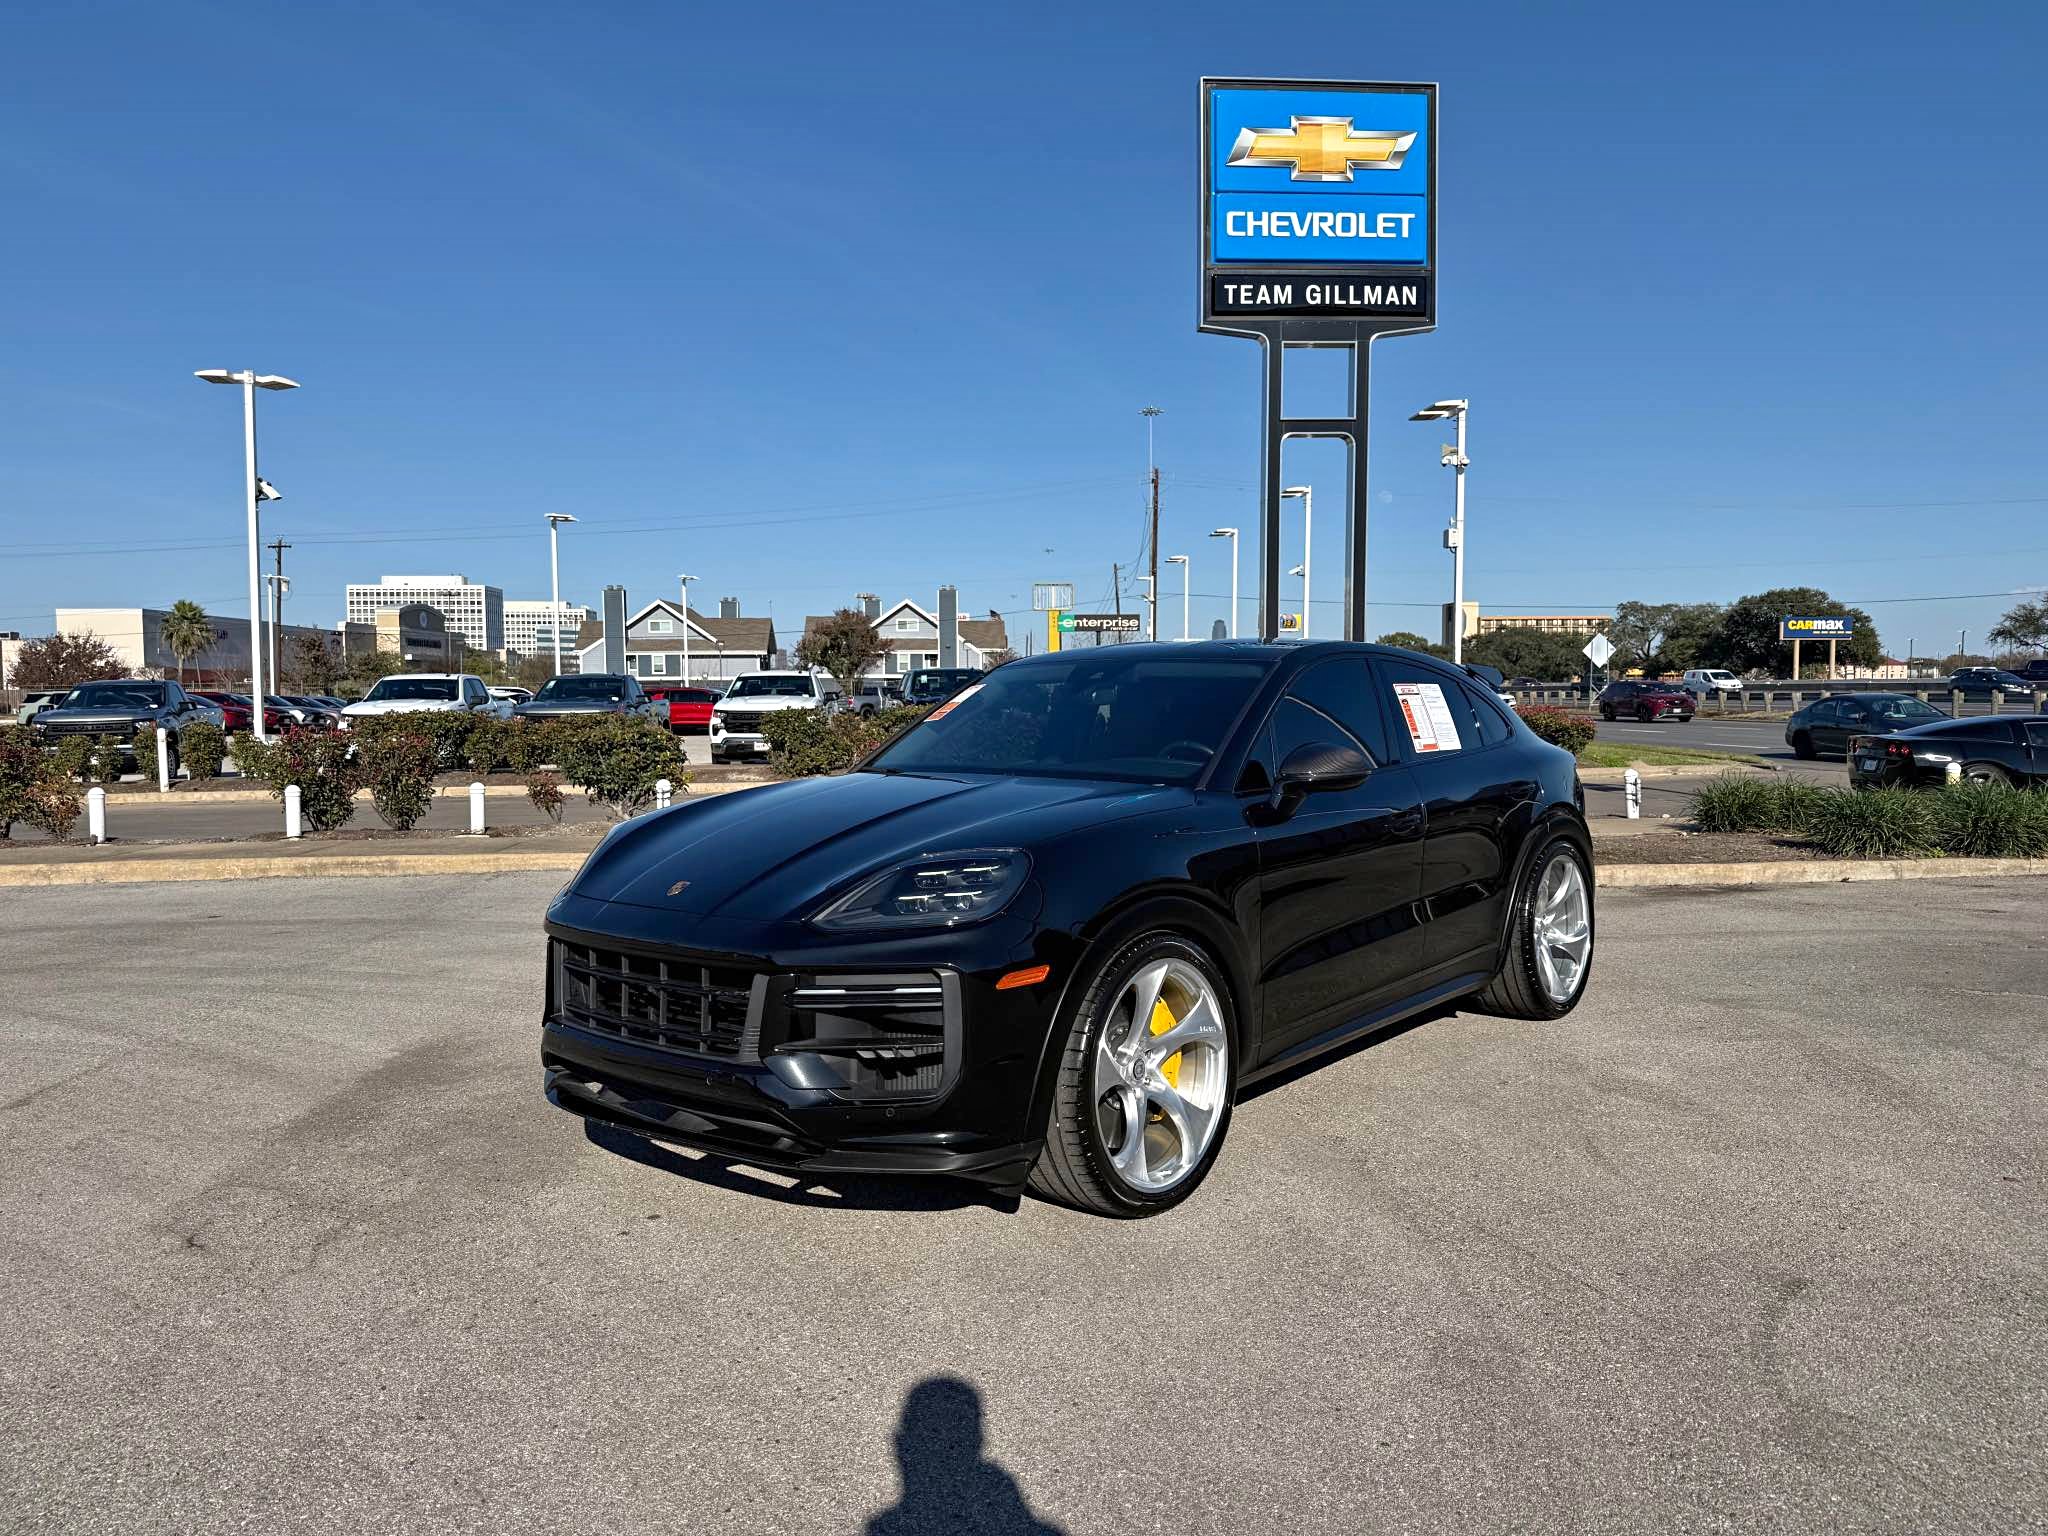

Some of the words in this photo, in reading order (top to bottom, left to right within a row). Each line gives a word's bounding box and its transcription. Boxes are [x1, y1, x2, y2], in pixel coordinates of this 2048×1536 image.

[1226, 211, 1416, 238] CHEVROLET
[1224, 284, 1293, 305] TEAM
[1305, 284, 1418, 306] GILLMAN
[1059, 617, 1139, 629] enterprise
